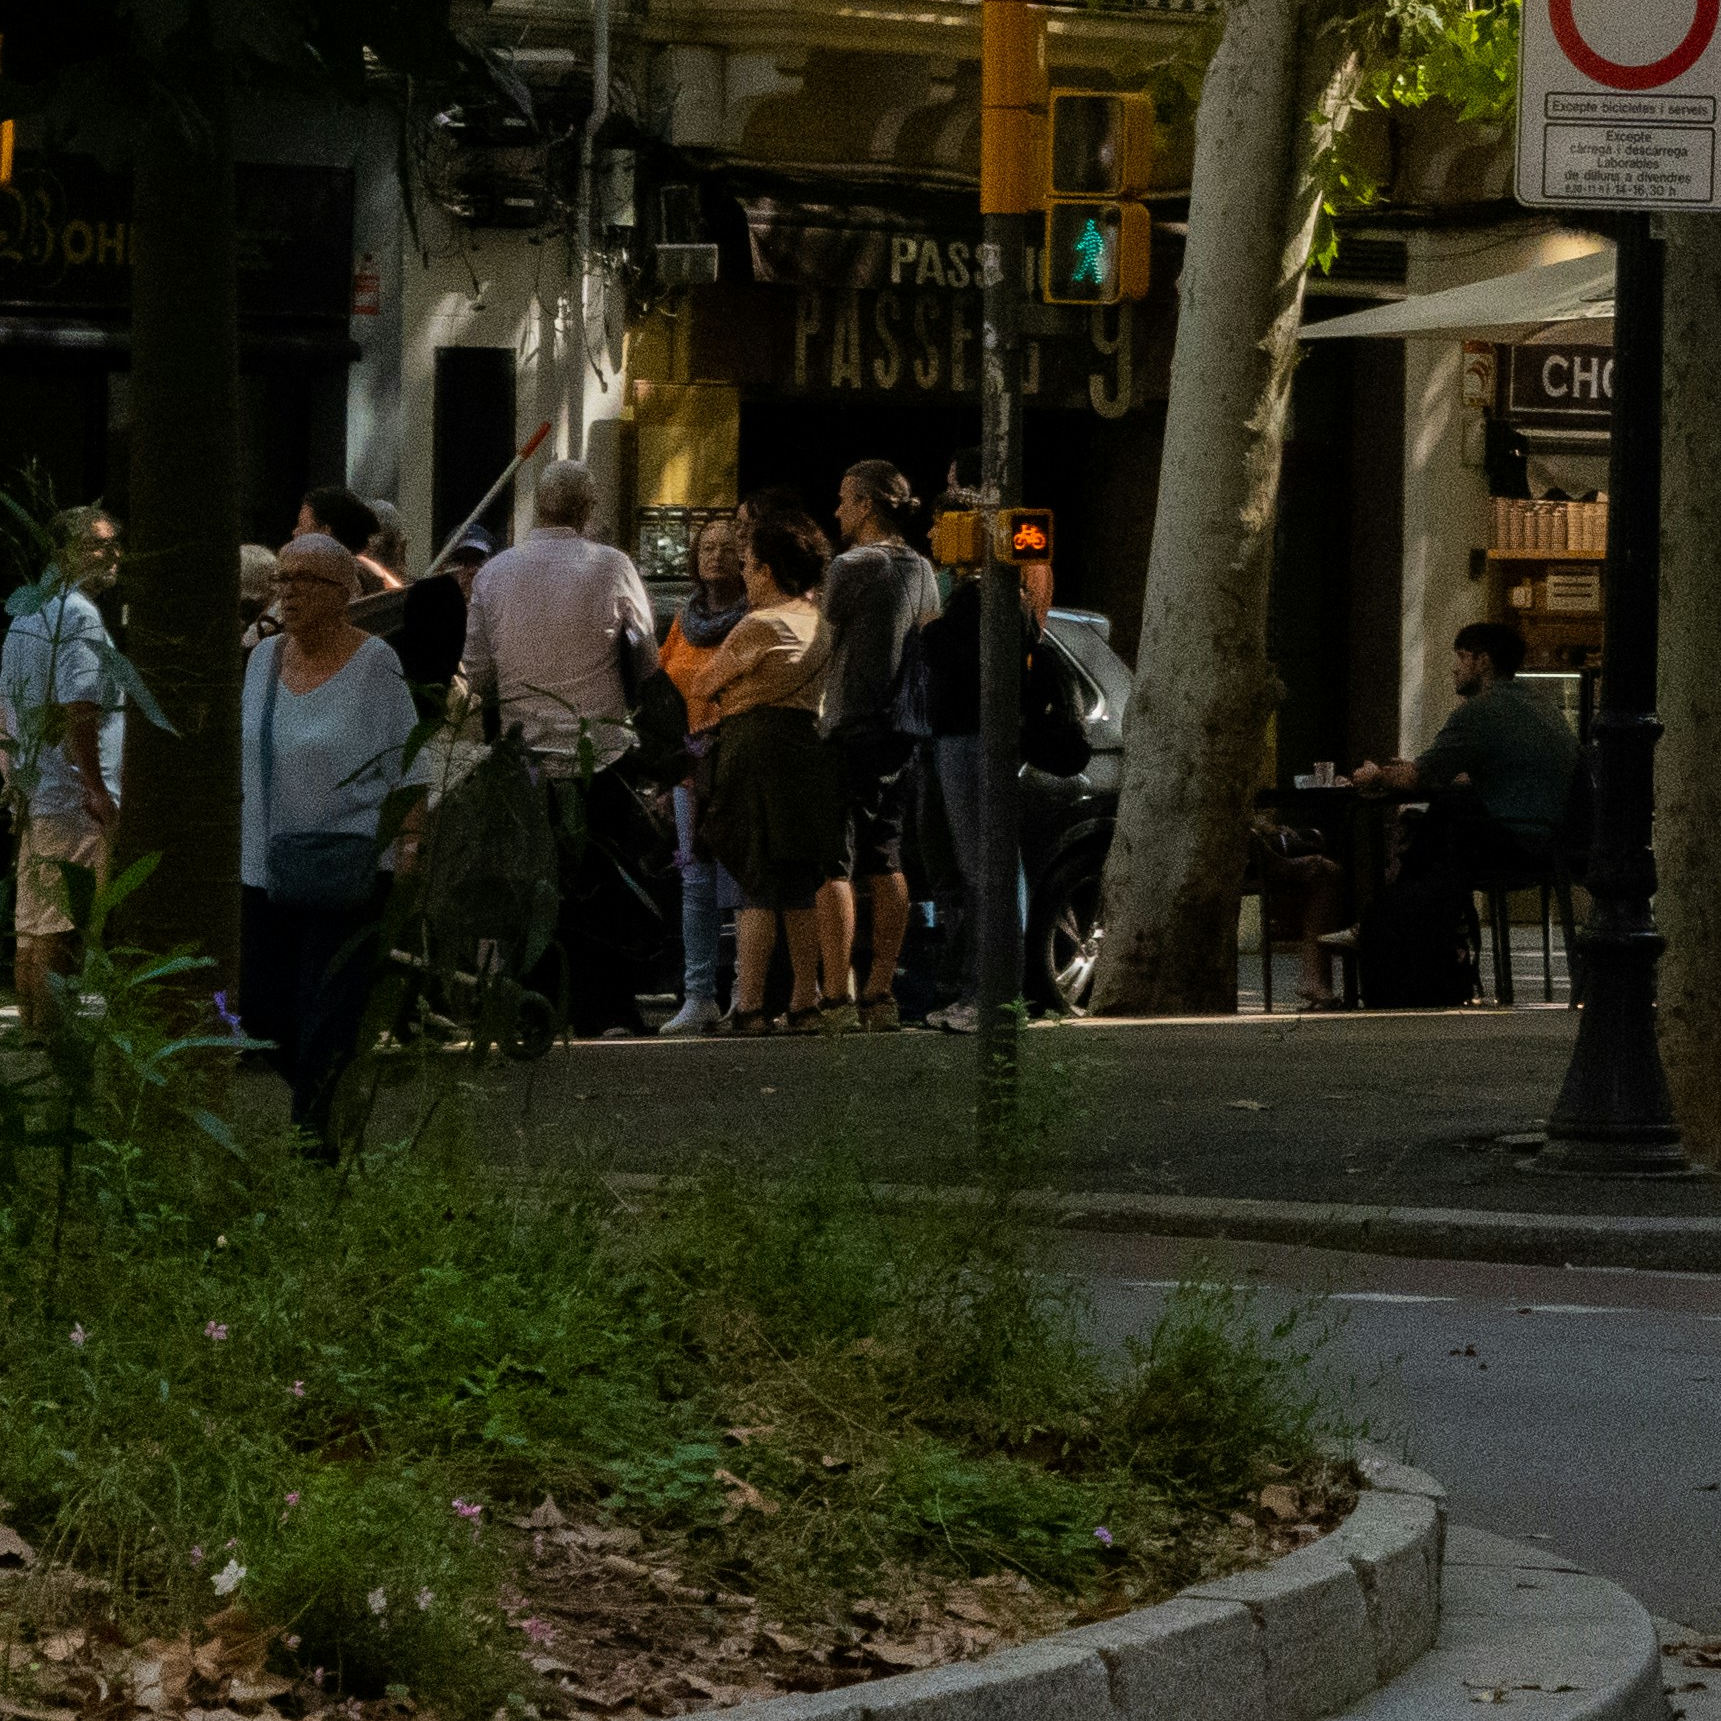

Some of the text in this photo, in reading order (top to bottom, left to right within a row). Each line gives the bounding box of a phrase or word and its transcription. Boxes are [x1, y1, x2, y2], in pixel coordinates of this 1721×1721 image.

[1552, 100, 1598, 114] Excepte
[1602, 101, 1656, 114] bicicletes
[1668, 104, 1709, 116] serveis
[1606, 130, 1651, 142] Excepte
[1597, 158, 1659, 169] Laborables
[1584, 170, 1620, 181] dilluns
[1637, 172, 1691, 184] divendres
